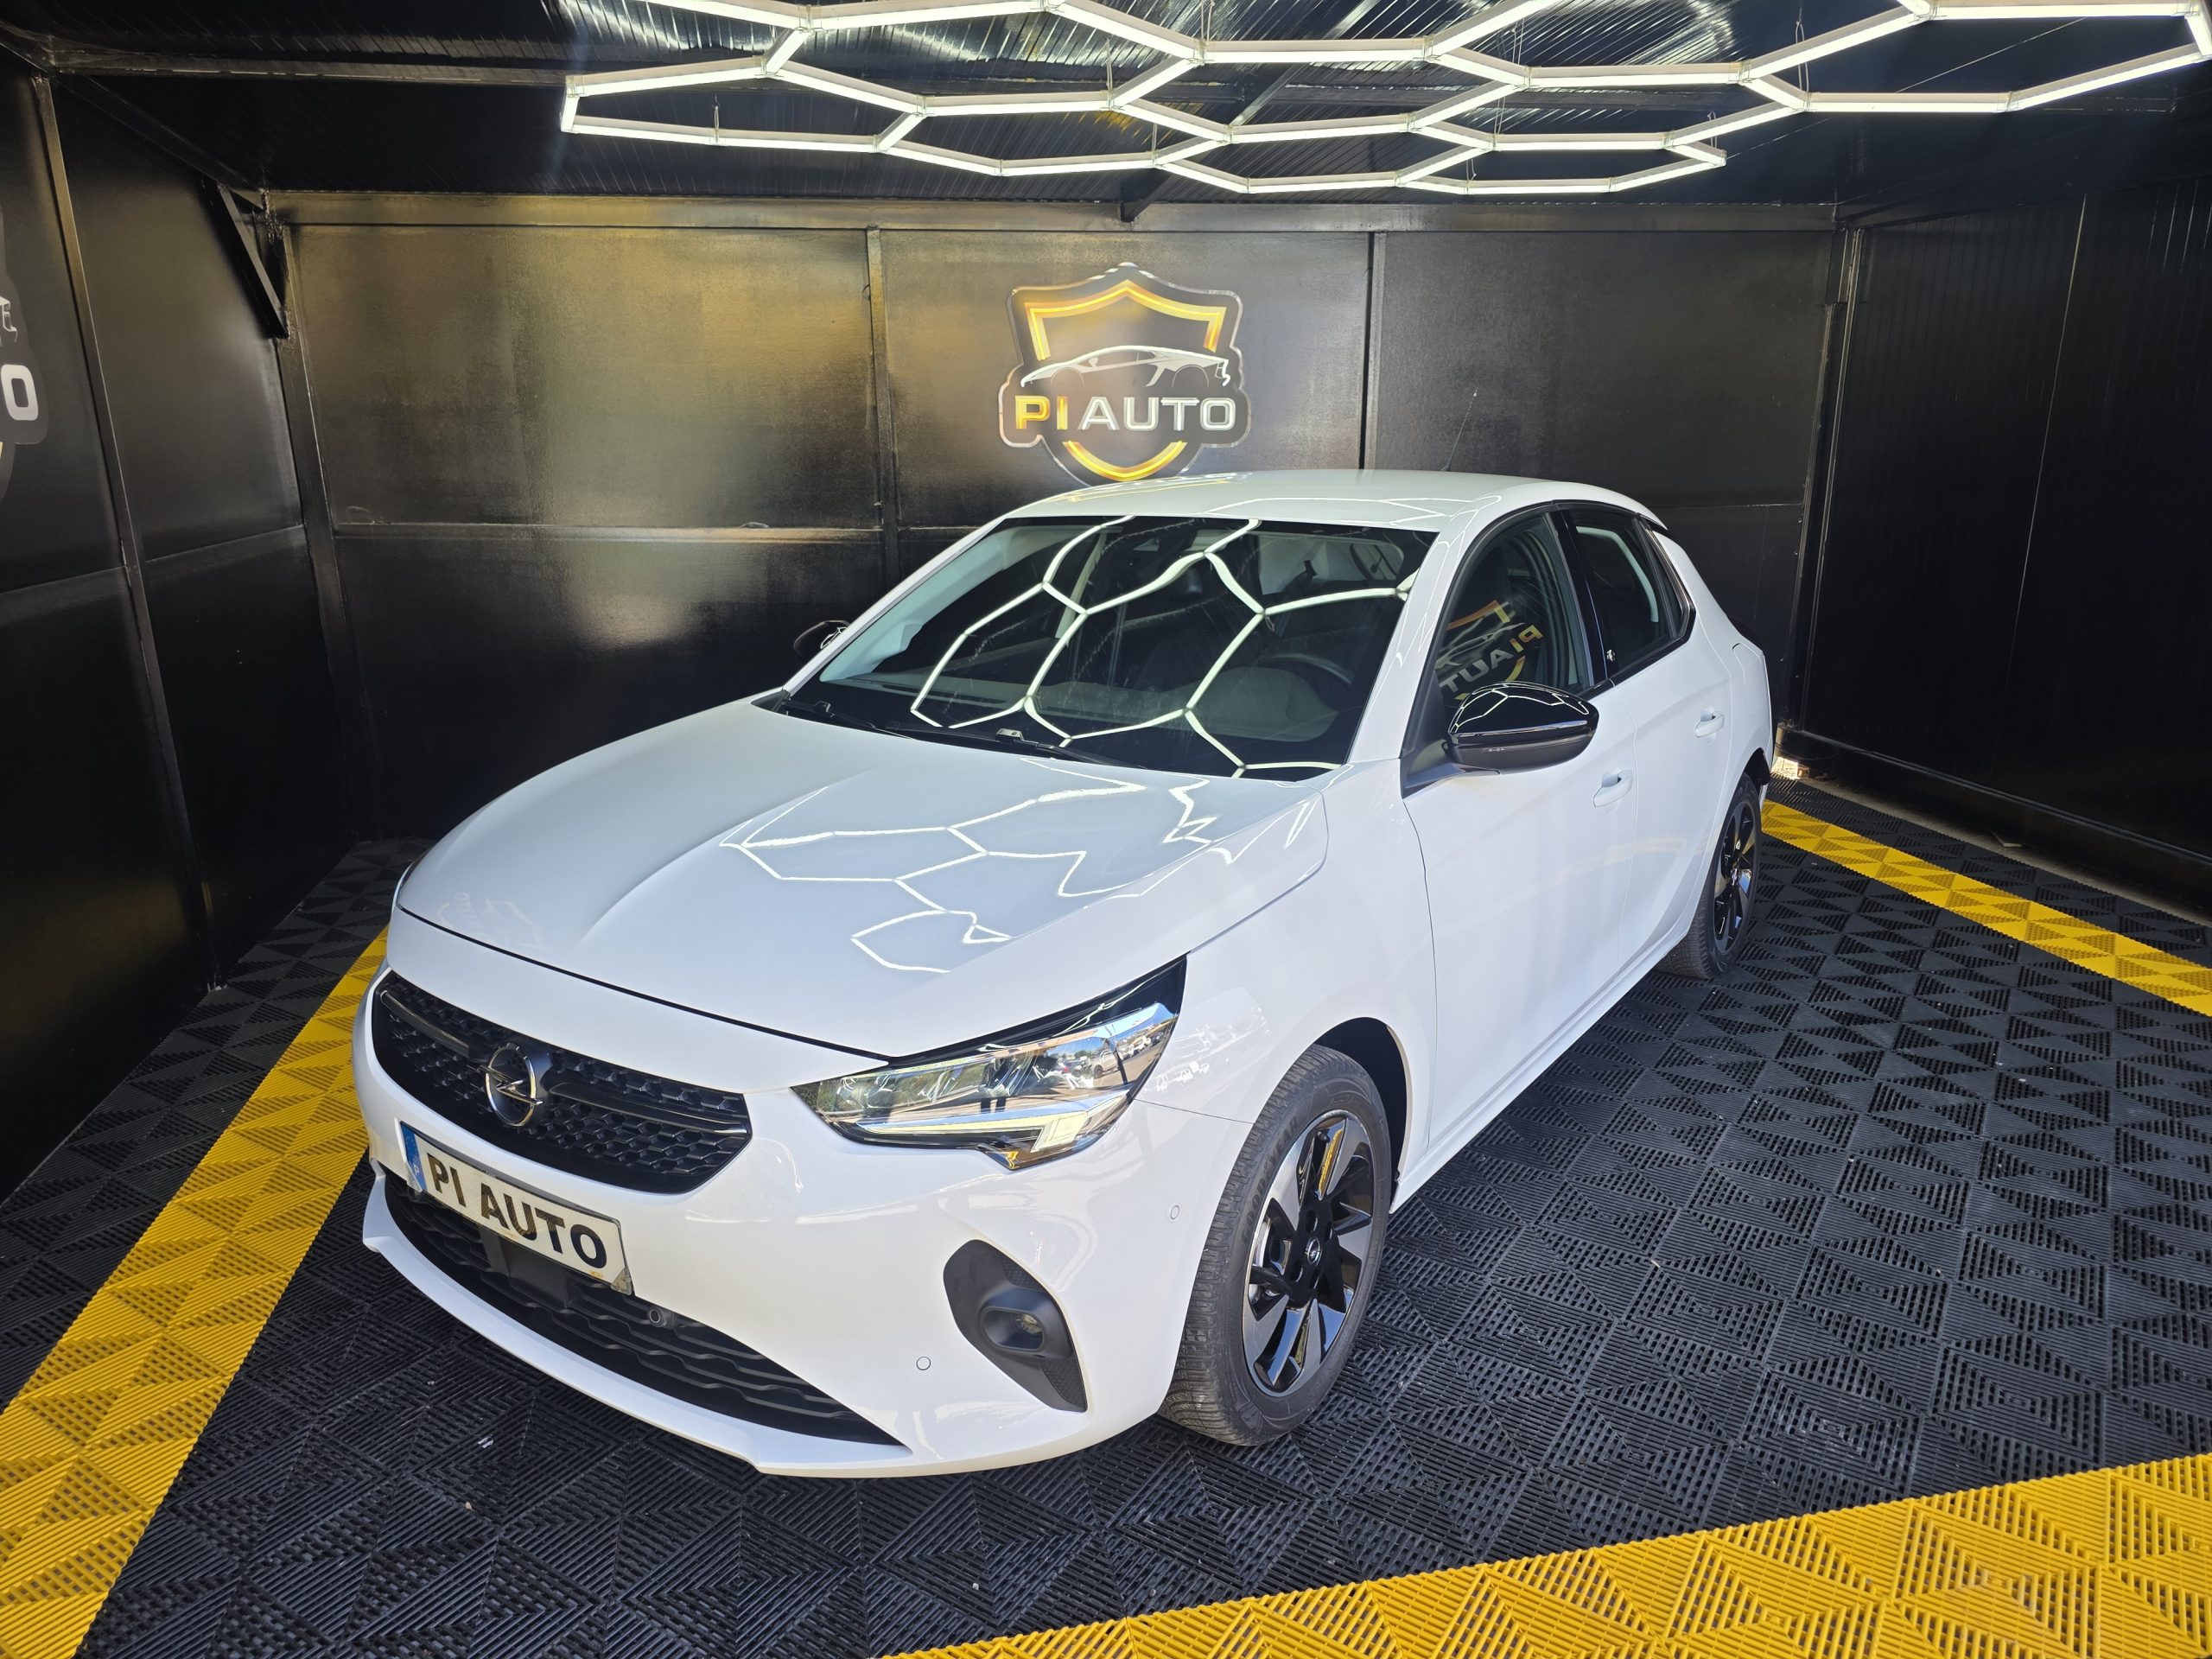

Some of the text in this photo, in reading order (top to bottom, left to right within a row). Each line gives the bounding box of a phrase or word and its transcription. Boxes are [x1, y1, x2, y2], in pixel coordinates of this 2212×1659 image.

[1, 364, 39, 421] O
[1014, 395, 1236, 431] PI AUTO
[427, 1152, 607, 1269] PI AUTO
[1242, 1116, 1297, 1244] GOODYEAR
